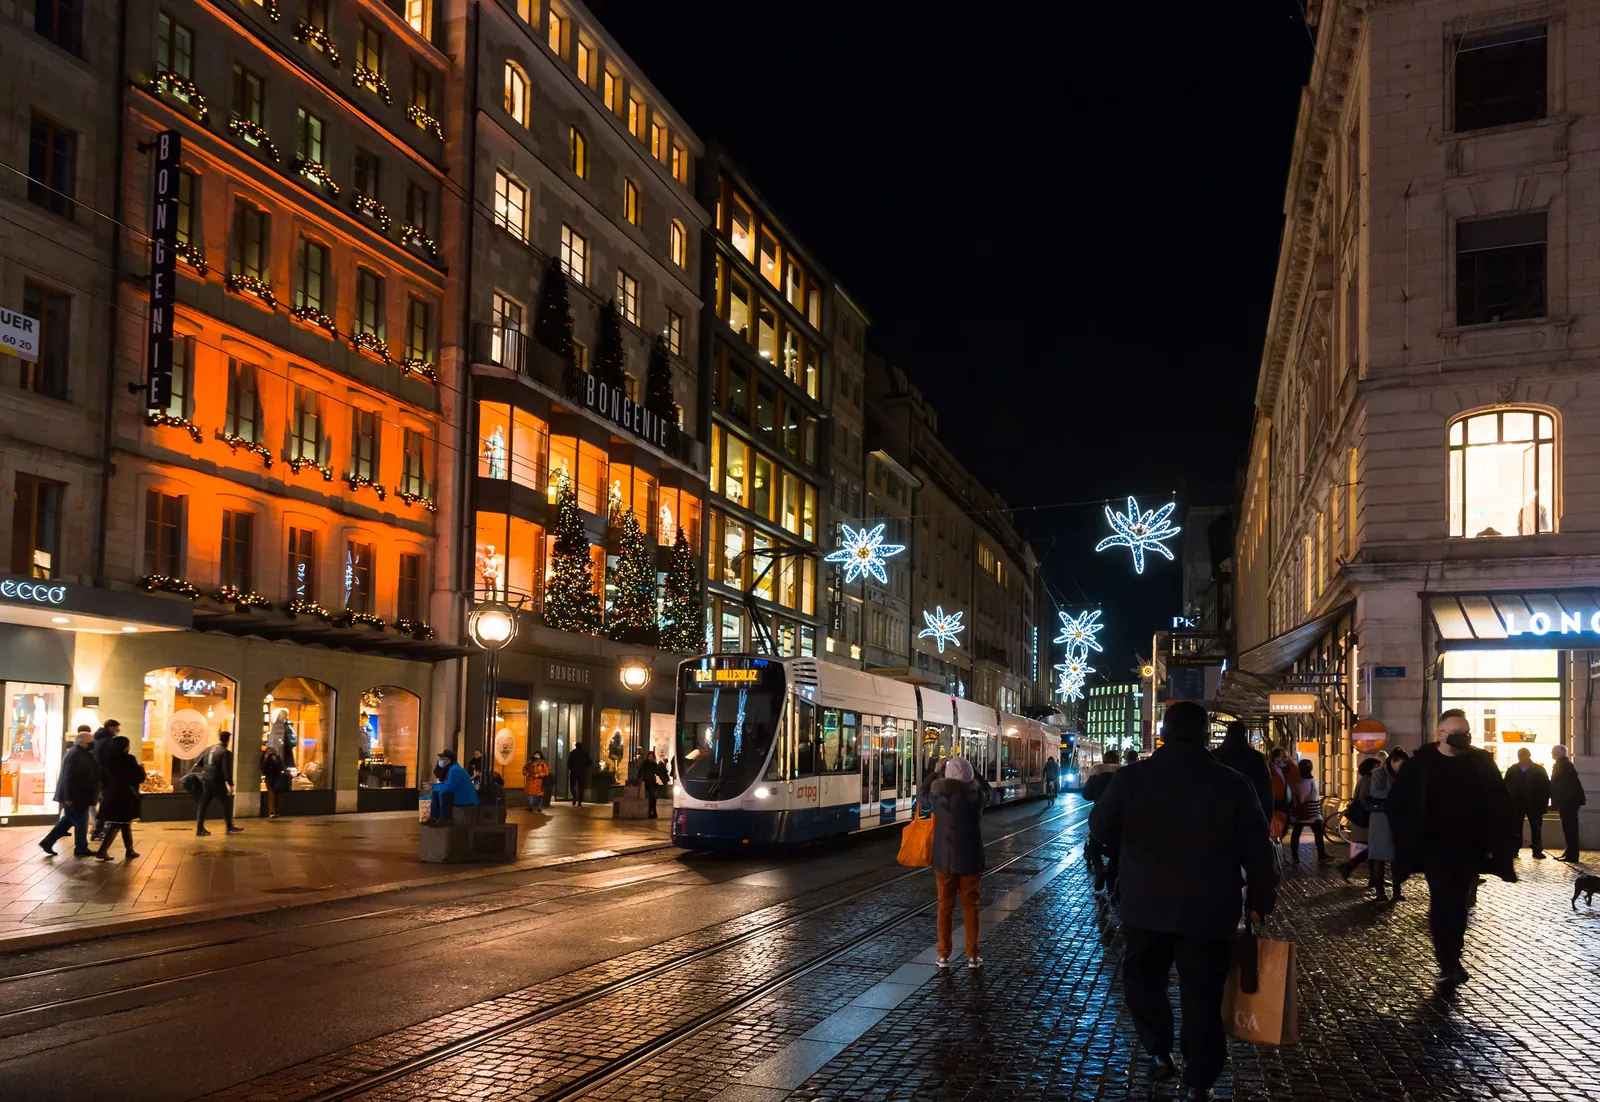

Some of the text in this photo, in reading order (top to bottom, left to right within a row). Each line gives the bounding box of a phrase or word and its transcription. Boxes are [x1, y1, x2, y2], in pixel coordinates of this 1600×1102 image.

[151, 134, 169, 404] BONGENIE
[3, 334, 32, 351] 60 20
[587, 373, 667, 448] BONGENIE
[834, 522, 842, 630] BOGENIE
[1, 579, 67, 604] ecco
[549, 664, 589, 684] BONGENIE
[697, 670, 710, 681] 12
